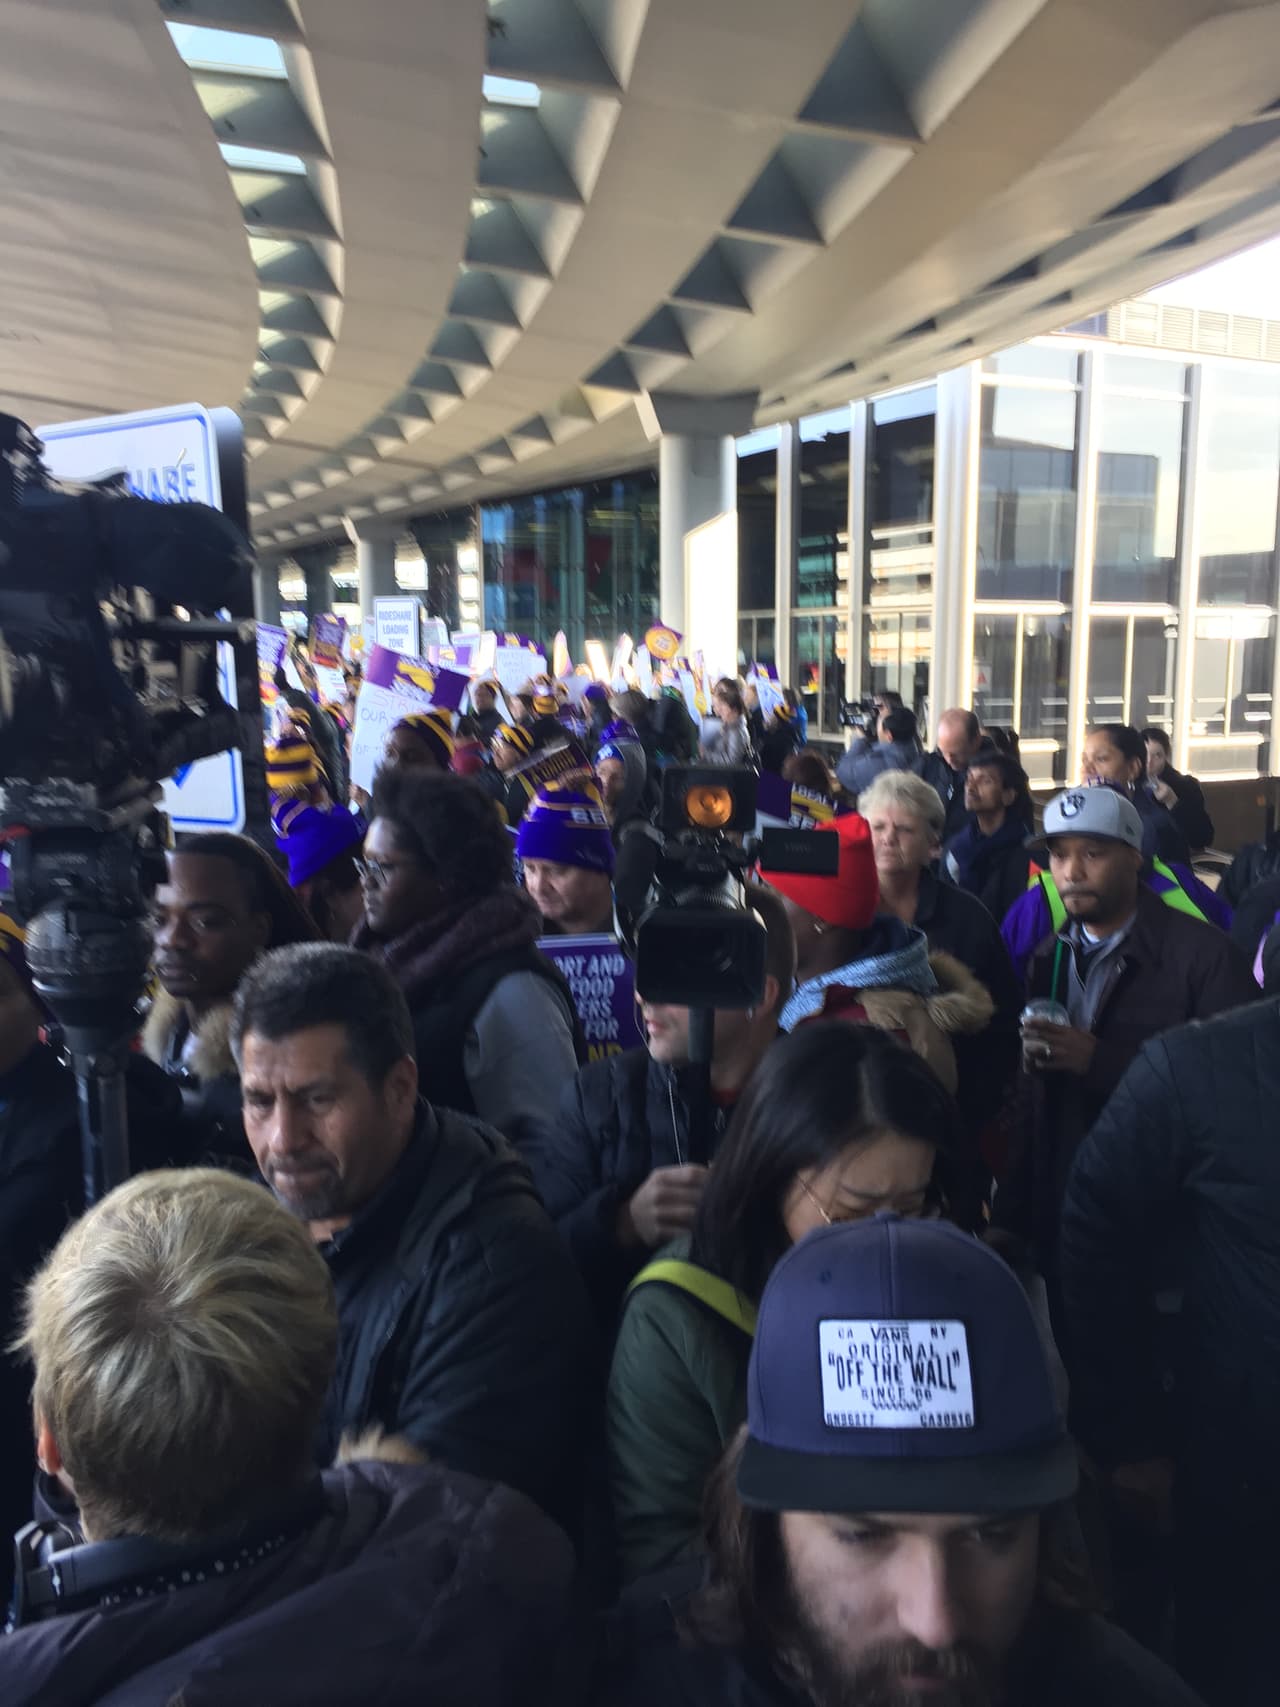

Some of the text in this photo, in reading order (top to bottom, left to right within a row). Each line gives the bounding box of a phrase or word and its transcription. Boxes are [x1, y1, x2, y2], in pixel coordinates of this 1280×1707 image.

[378, 610, 412, 620] RIDESHARE
[382, 624, 409, 634] LOADING
[388, 638, 404, 648] ZONE
[588, 954, 625, 977] AND
[584, 1017, 619, 1040] FOR
[870, 1327, 910, 1341] VANS
[848, 1343, 935, 1363] ORIGINAL
[873, 1362, 903, 1386] THE
